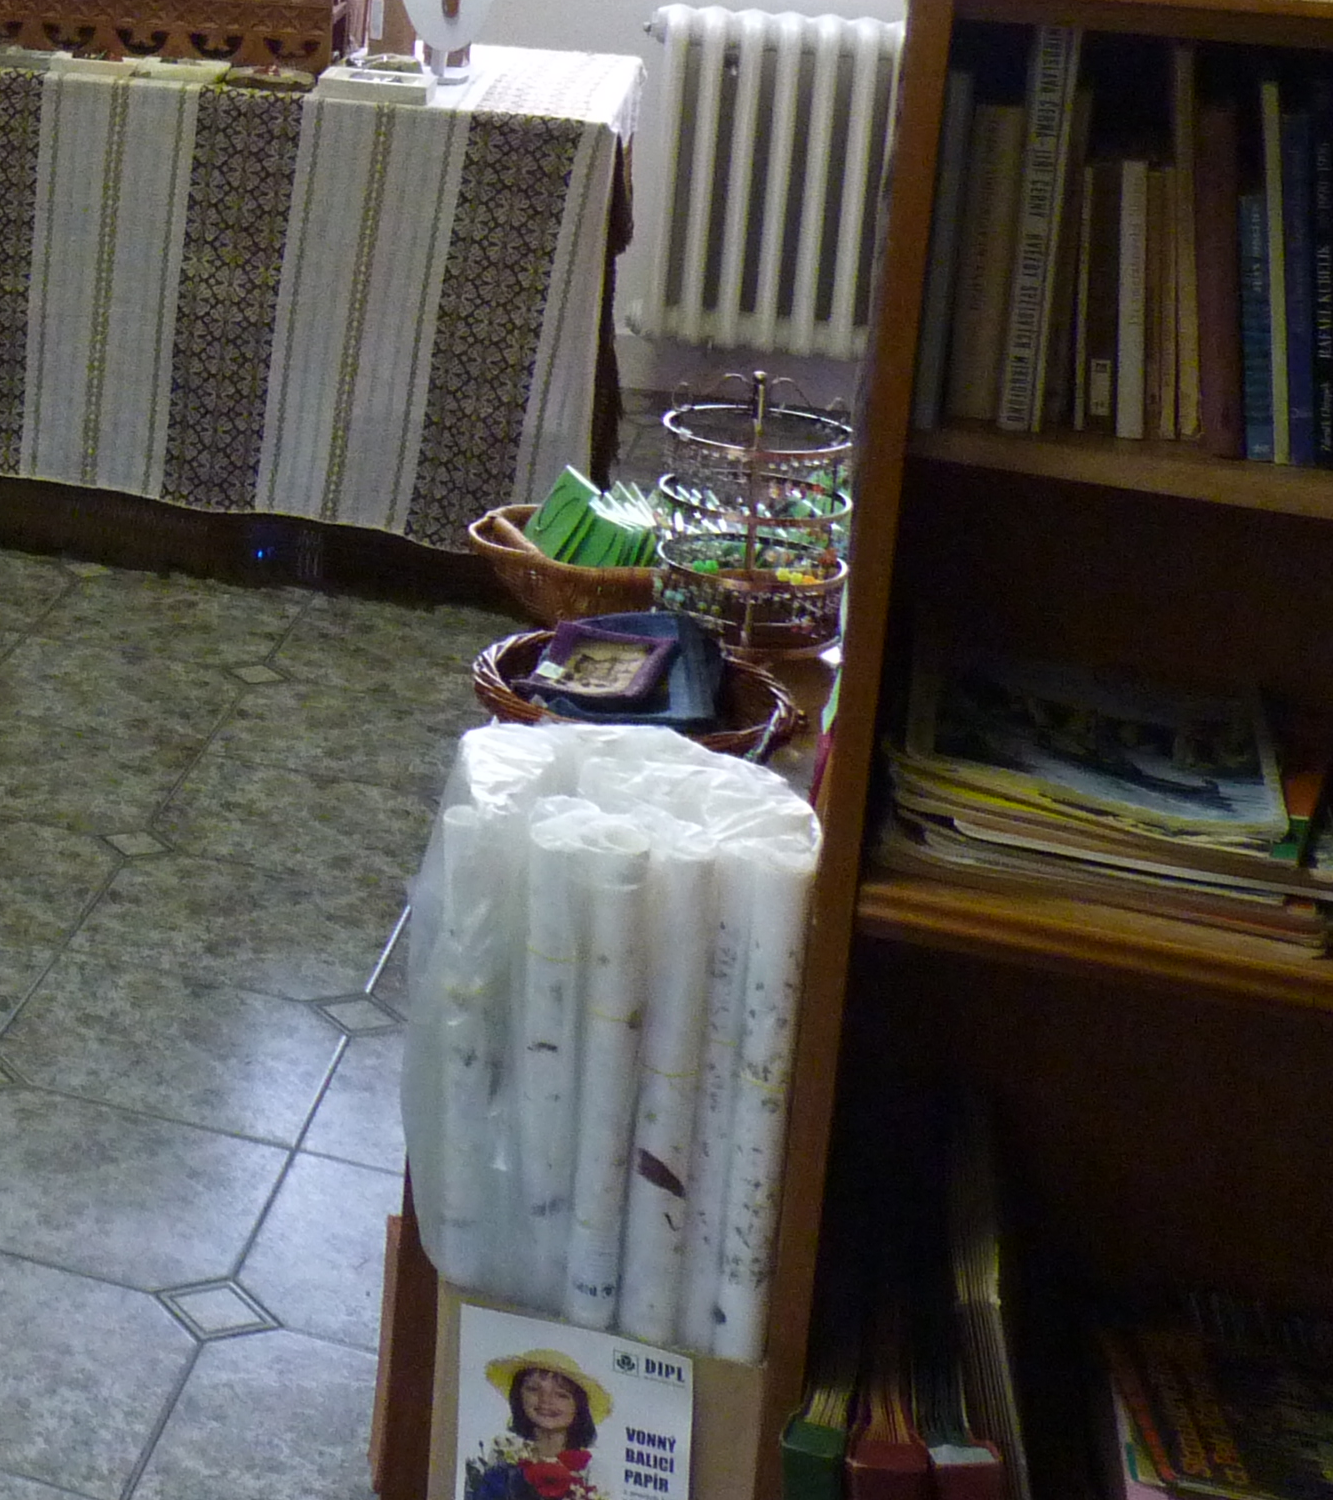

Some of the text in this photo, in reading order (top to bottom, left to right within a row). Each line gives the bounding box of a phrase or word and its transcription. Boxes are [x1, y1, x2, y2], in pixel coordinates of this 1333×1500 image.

[643, 1356, 686, 1383] DIPL
[625, 1425, 677, 1454] VONNÝ
[623, 1467, 669, 1493] PAPÍR
